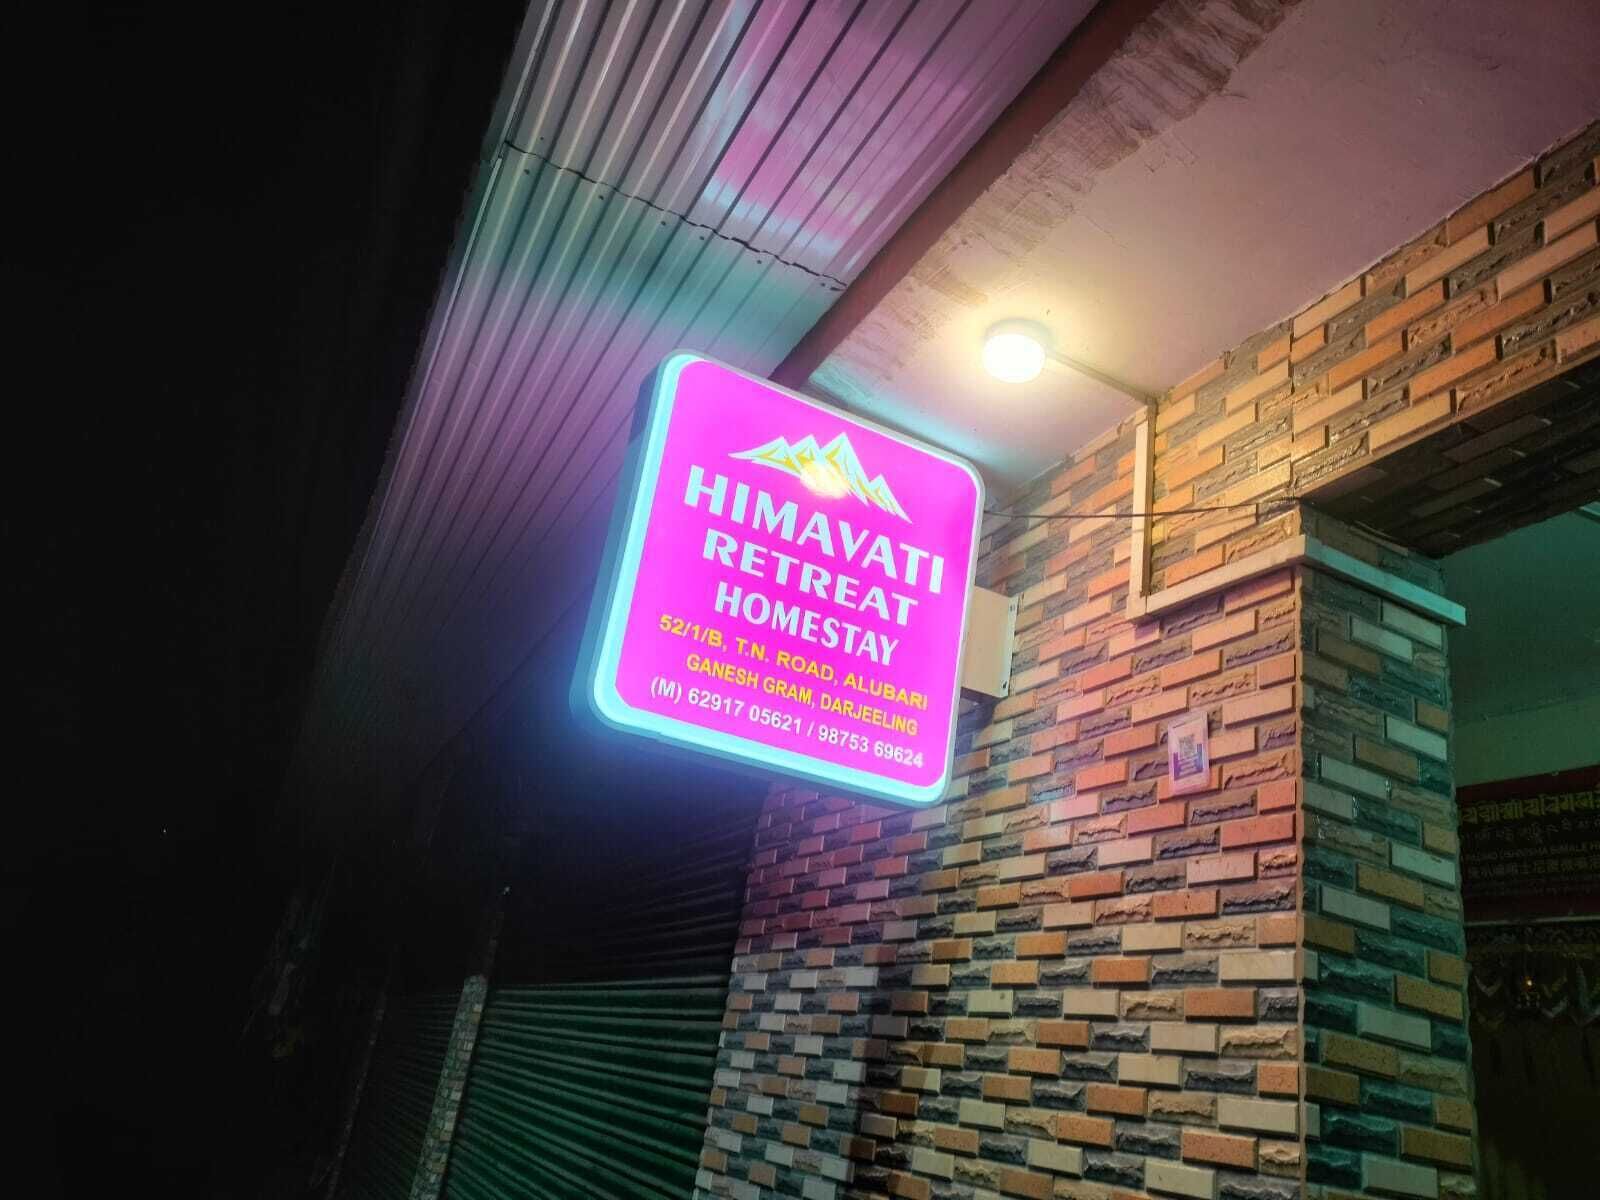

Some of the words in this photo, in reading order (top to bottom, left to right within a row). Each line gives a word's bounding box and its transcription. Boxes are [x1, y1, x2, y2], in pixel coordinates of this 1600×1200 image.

[684, 464, 944, 594] HIMAVATI
[703, 528, 919, 626] RETREAT
[714, 581, 900, 667] HOMESTAY
[659, 614, 728, 652] 52/1/B,
[736, 636, 770, 664] T.N.
[776, 650, 839, 687] ROAD,
[843, 672, 928, 711] ALUBARI
[686, 653, 759, 689] GANESH
[763, 676, 815, 709] GRAM,
[820, 693, 919, 736] DARJEELING
[650, 676, 683, 703] (M)
[687, 686, 744, 717] 62917
[749, 706, 802, 735] 05621
[806, 721, 815, 737] /
[818, 727, 869, 753] 98753
[874, 740, 924, 769] 69624
